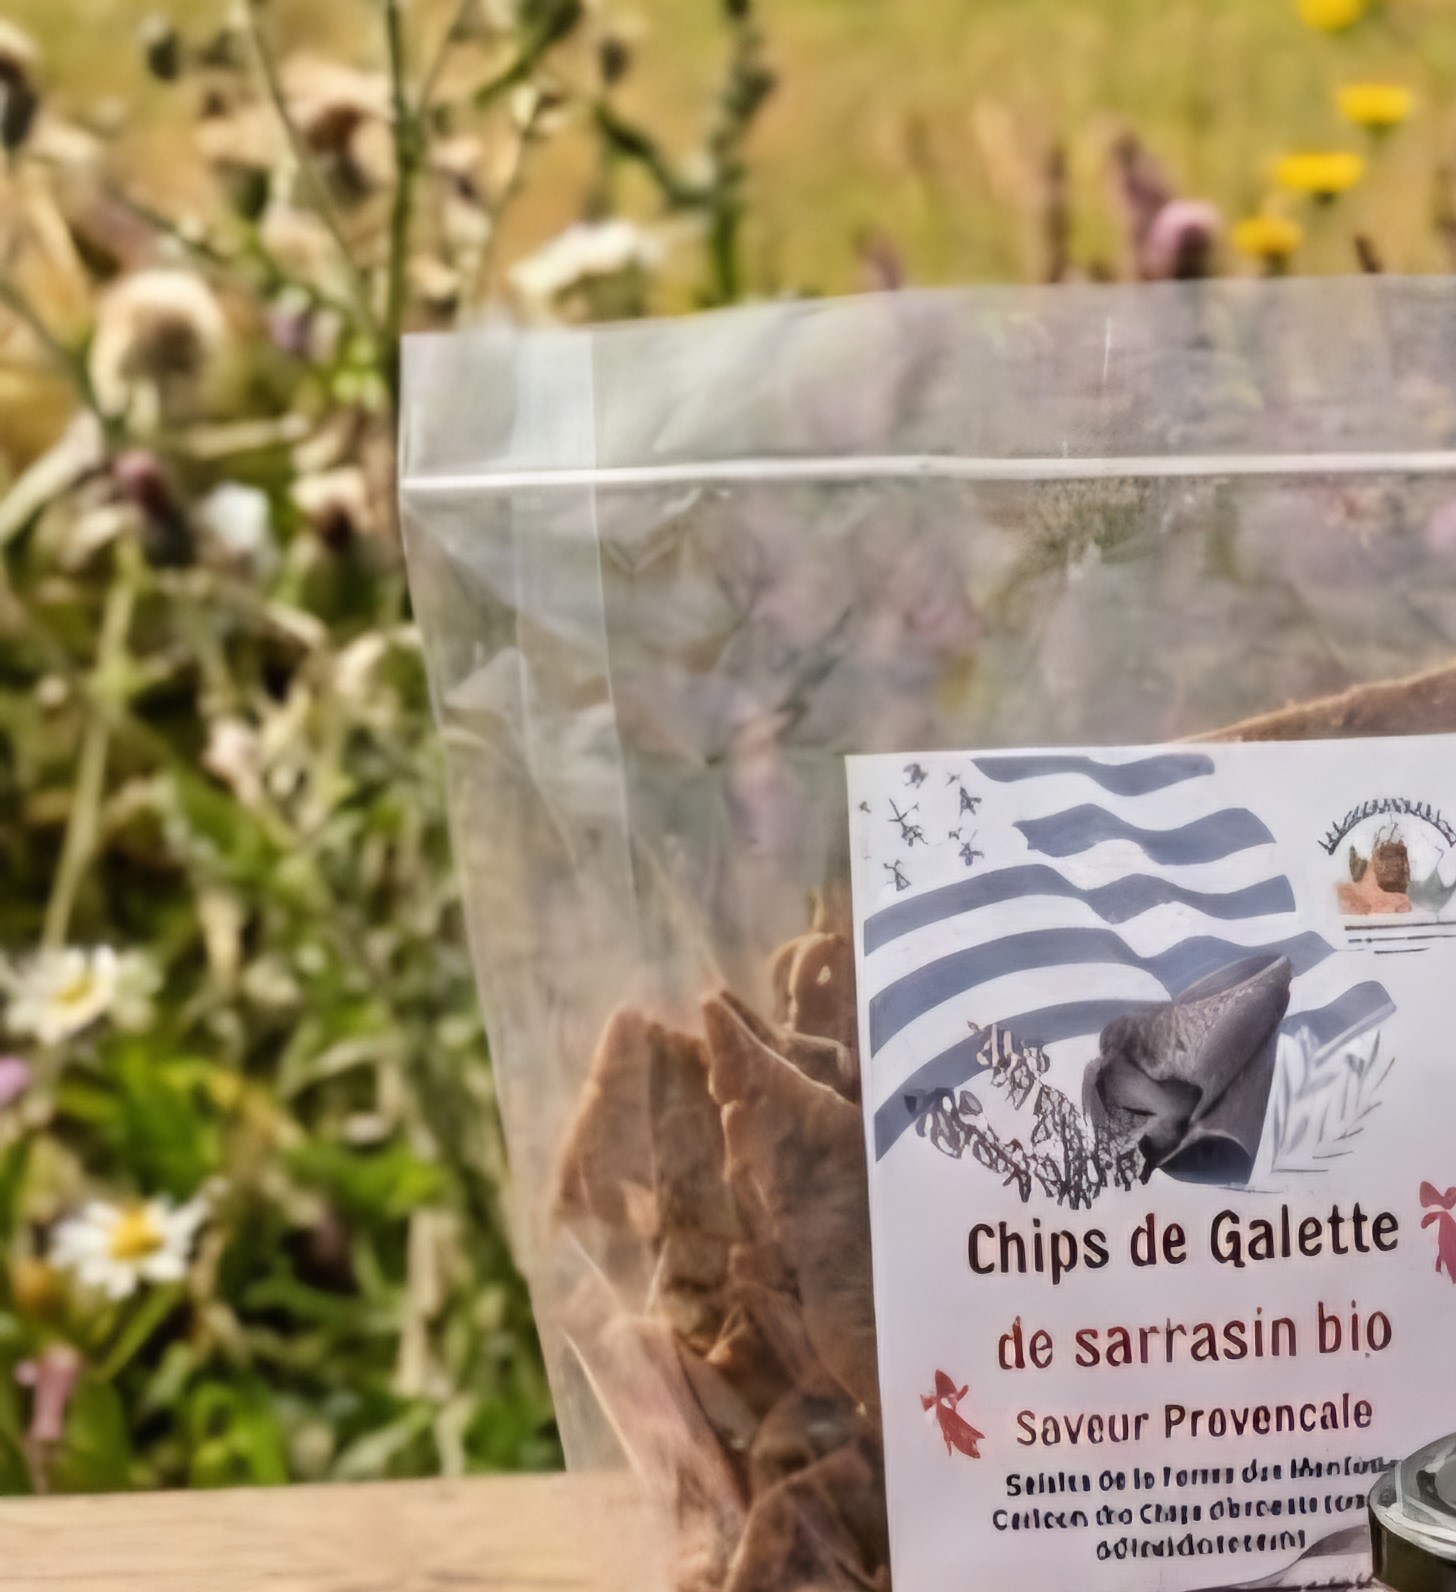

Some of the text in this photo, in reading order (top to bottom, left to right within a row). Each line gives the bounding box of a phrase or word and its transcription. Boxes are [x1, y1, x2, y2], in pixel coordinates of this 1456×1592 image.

[967, 1202, 1399, 1284] Chips de Galette
[997, 1301, 1392, 1370] de sarrasin bio
